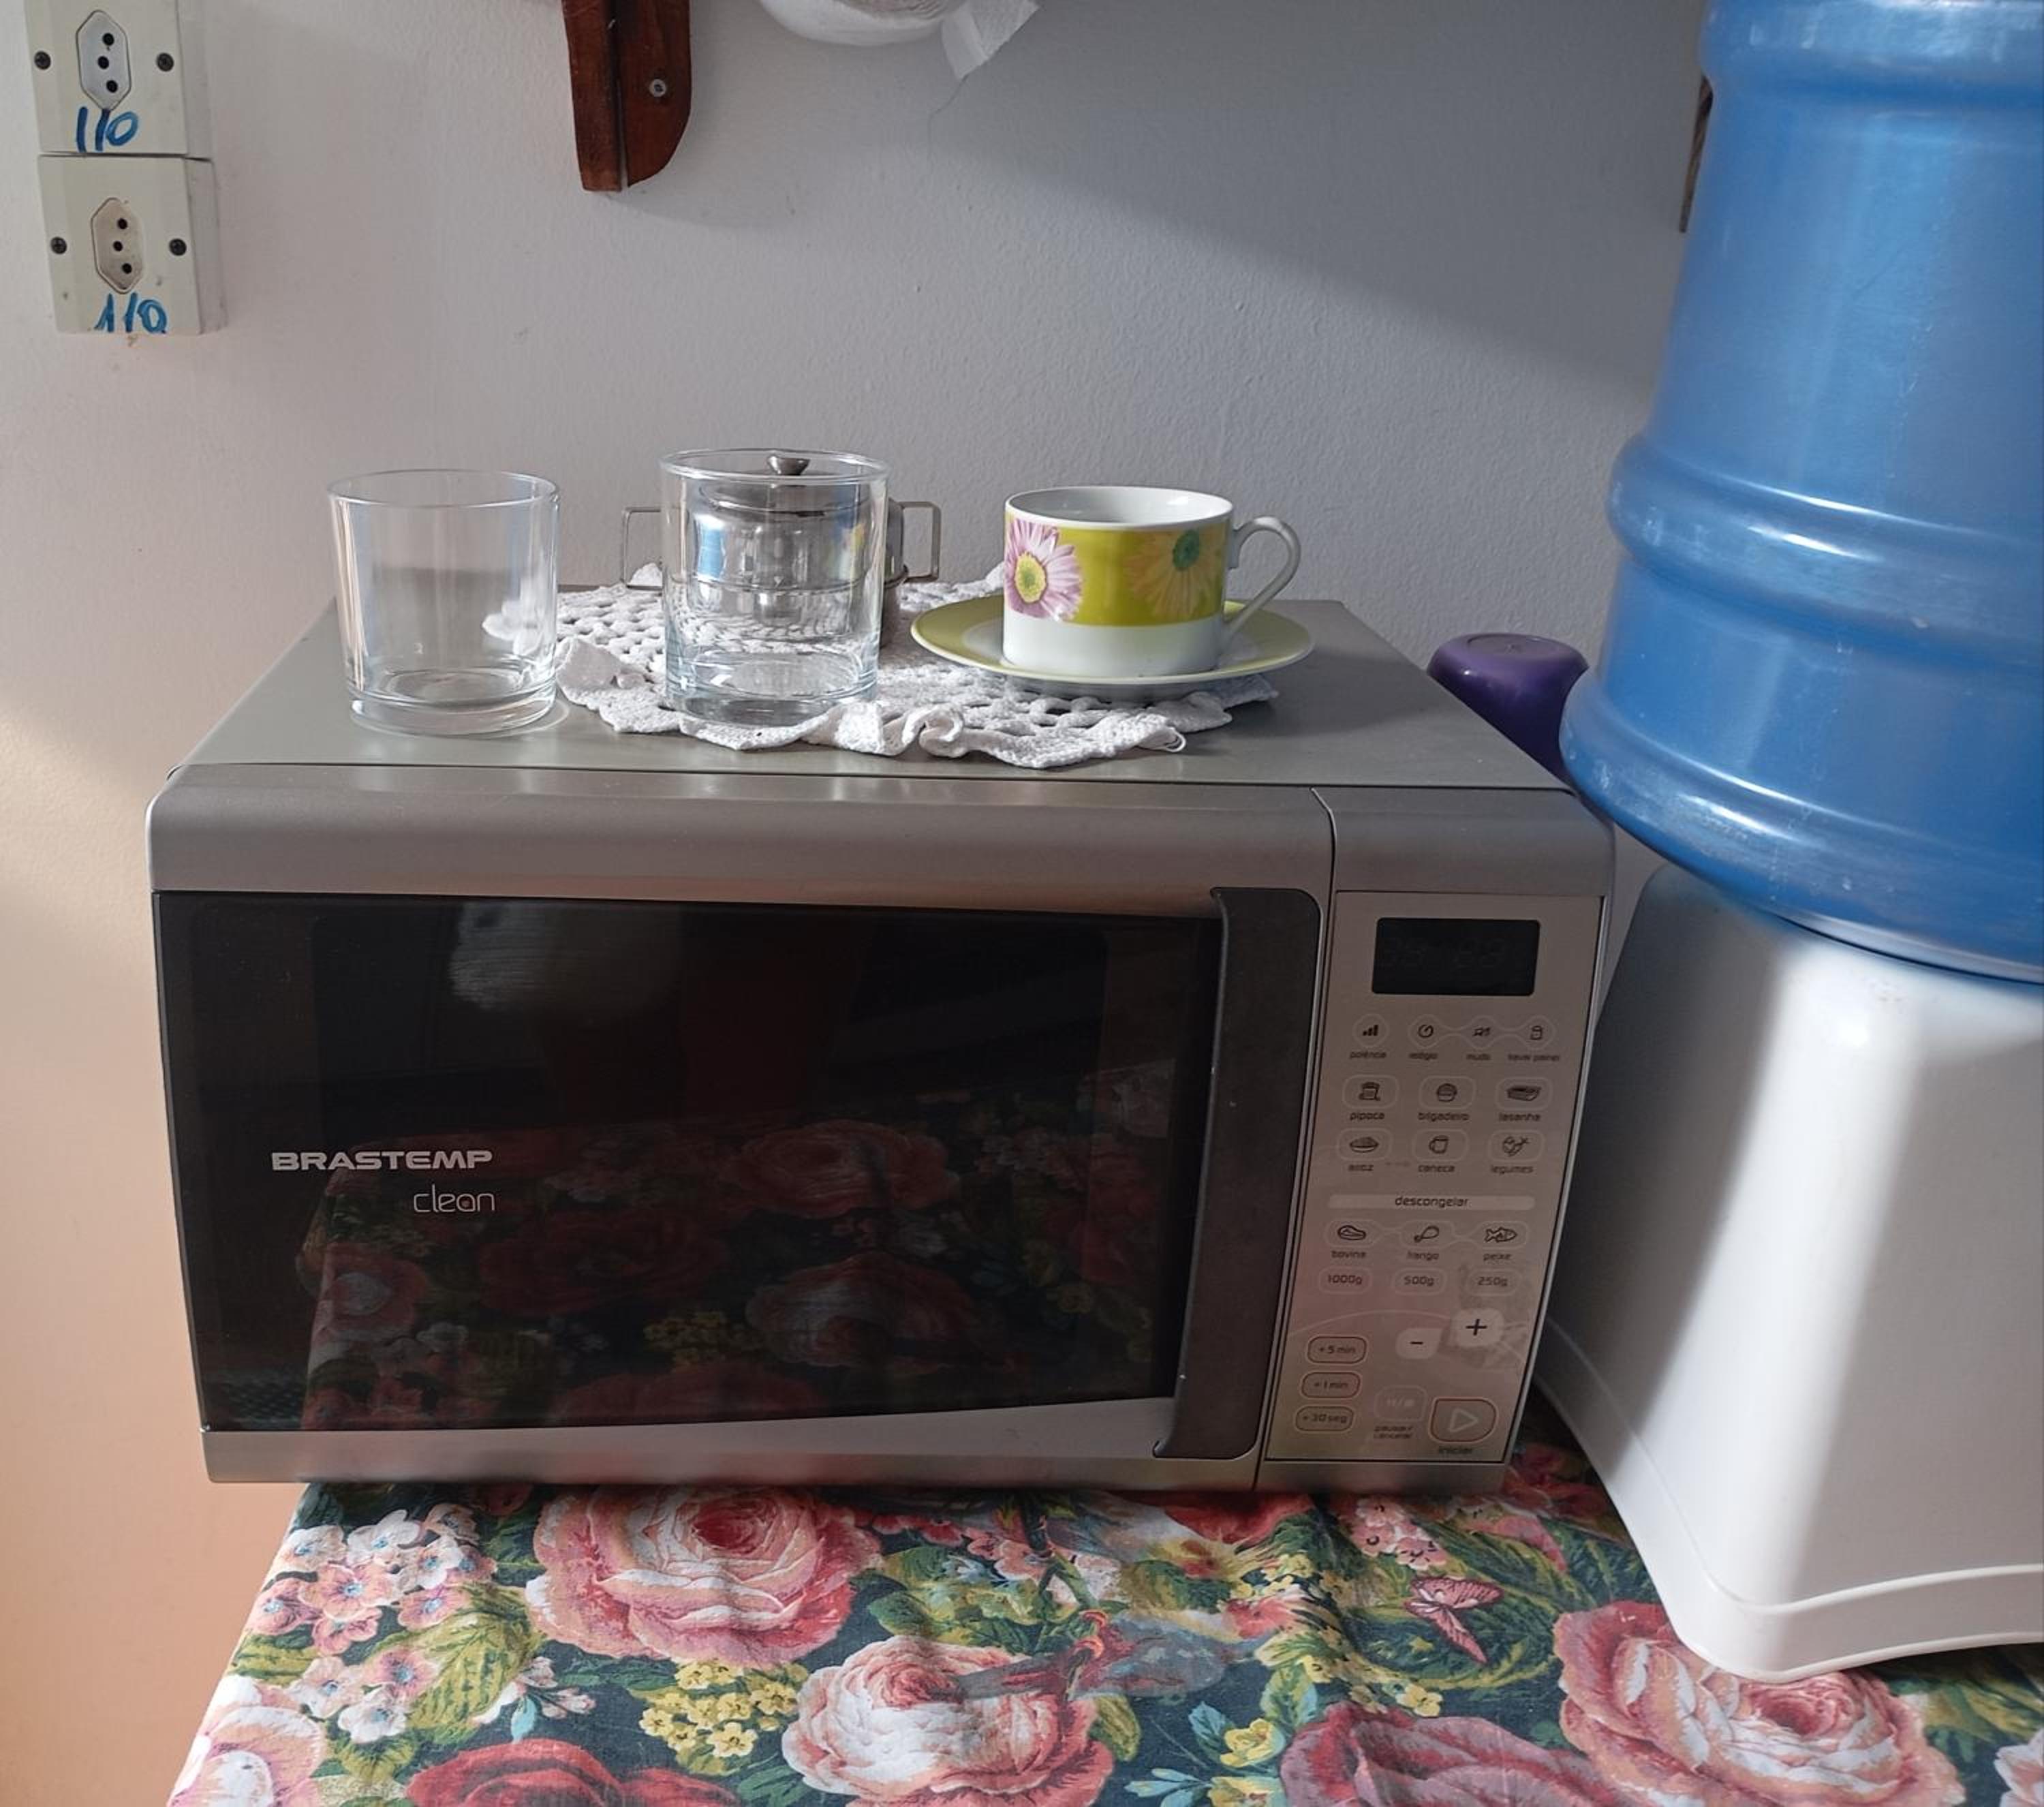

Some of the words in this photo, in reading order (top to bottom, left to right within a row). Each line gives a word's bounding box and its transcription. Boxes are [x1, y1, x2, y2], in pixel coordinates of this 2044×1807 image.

[76, 106, 138, 153] 110
[94, 292, 168, 334] 110
[1350, 1112, 1385, 1121] pipoca
[271, 1150, 493, 1171] BRASTEMP
[413, 1184, 496, 1213] clean
[1395, 1194, 1470, 1209] descongelar
[1327, 1274, 1363, 1286] 1000g
[1404, 1275, 1435, 1286] 500g
[1477, 1276, 1508, 1287] 250g
[1337, 1345, 1356, 1354] min
